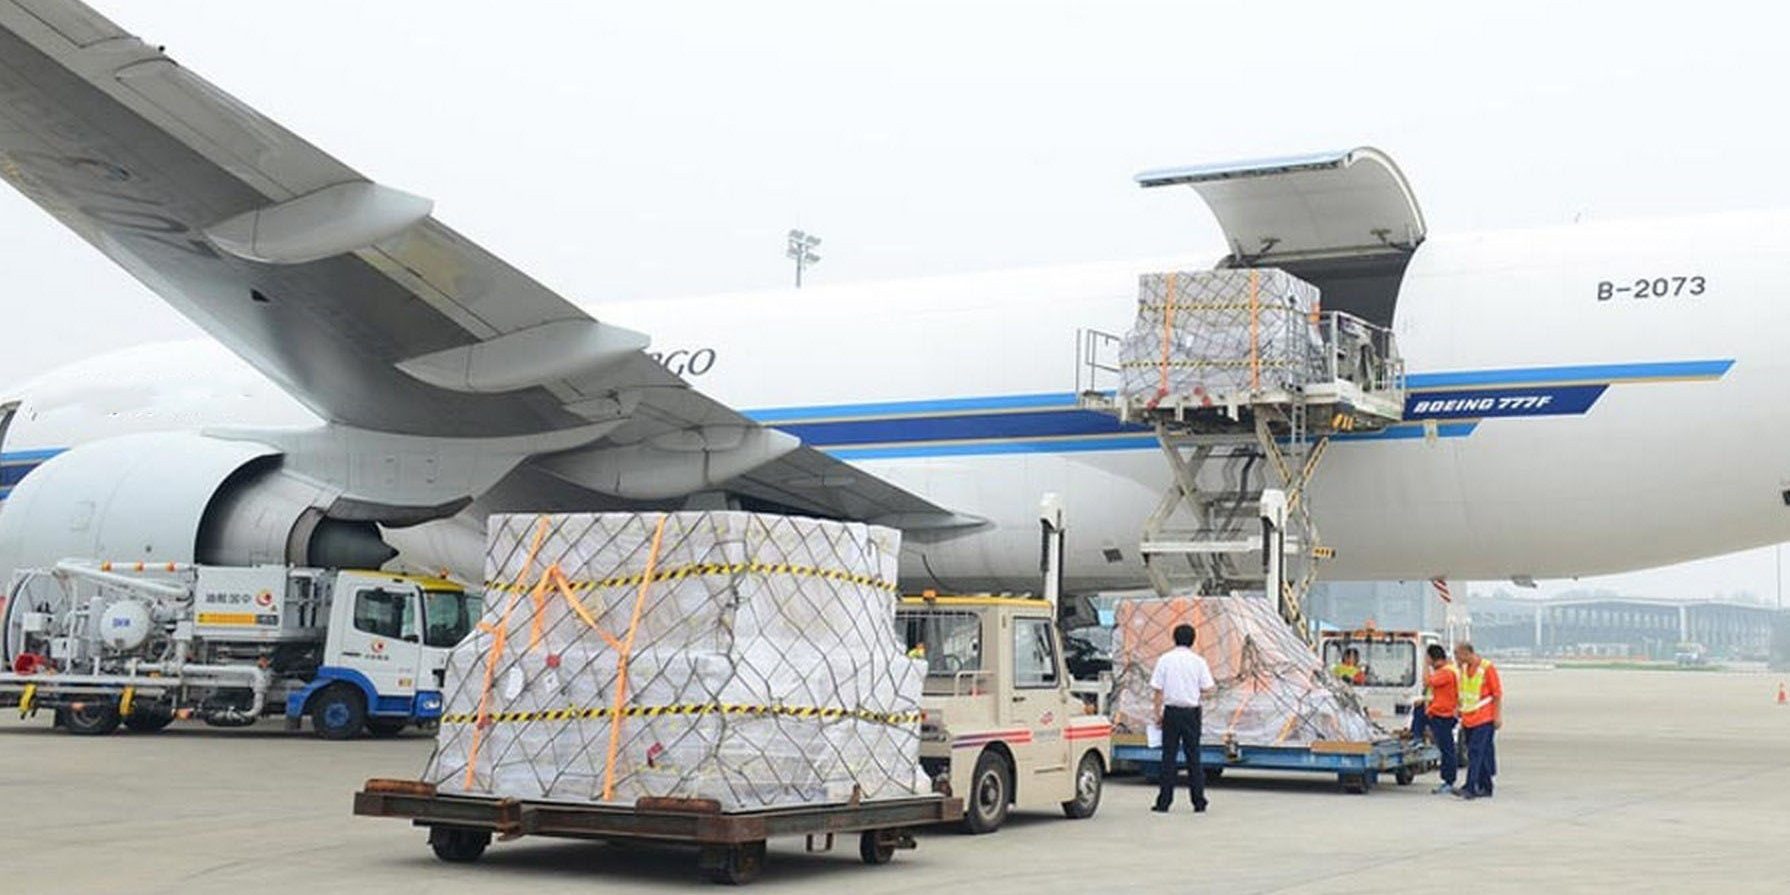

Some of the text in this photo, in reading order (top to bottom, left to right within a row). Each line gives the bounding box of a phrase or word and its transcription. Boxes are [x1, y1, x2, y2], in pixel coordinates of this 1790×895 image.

[1597, 276, 1706, 301] B-2073
[1413, 396, 1553, 413] BOEING 777F
